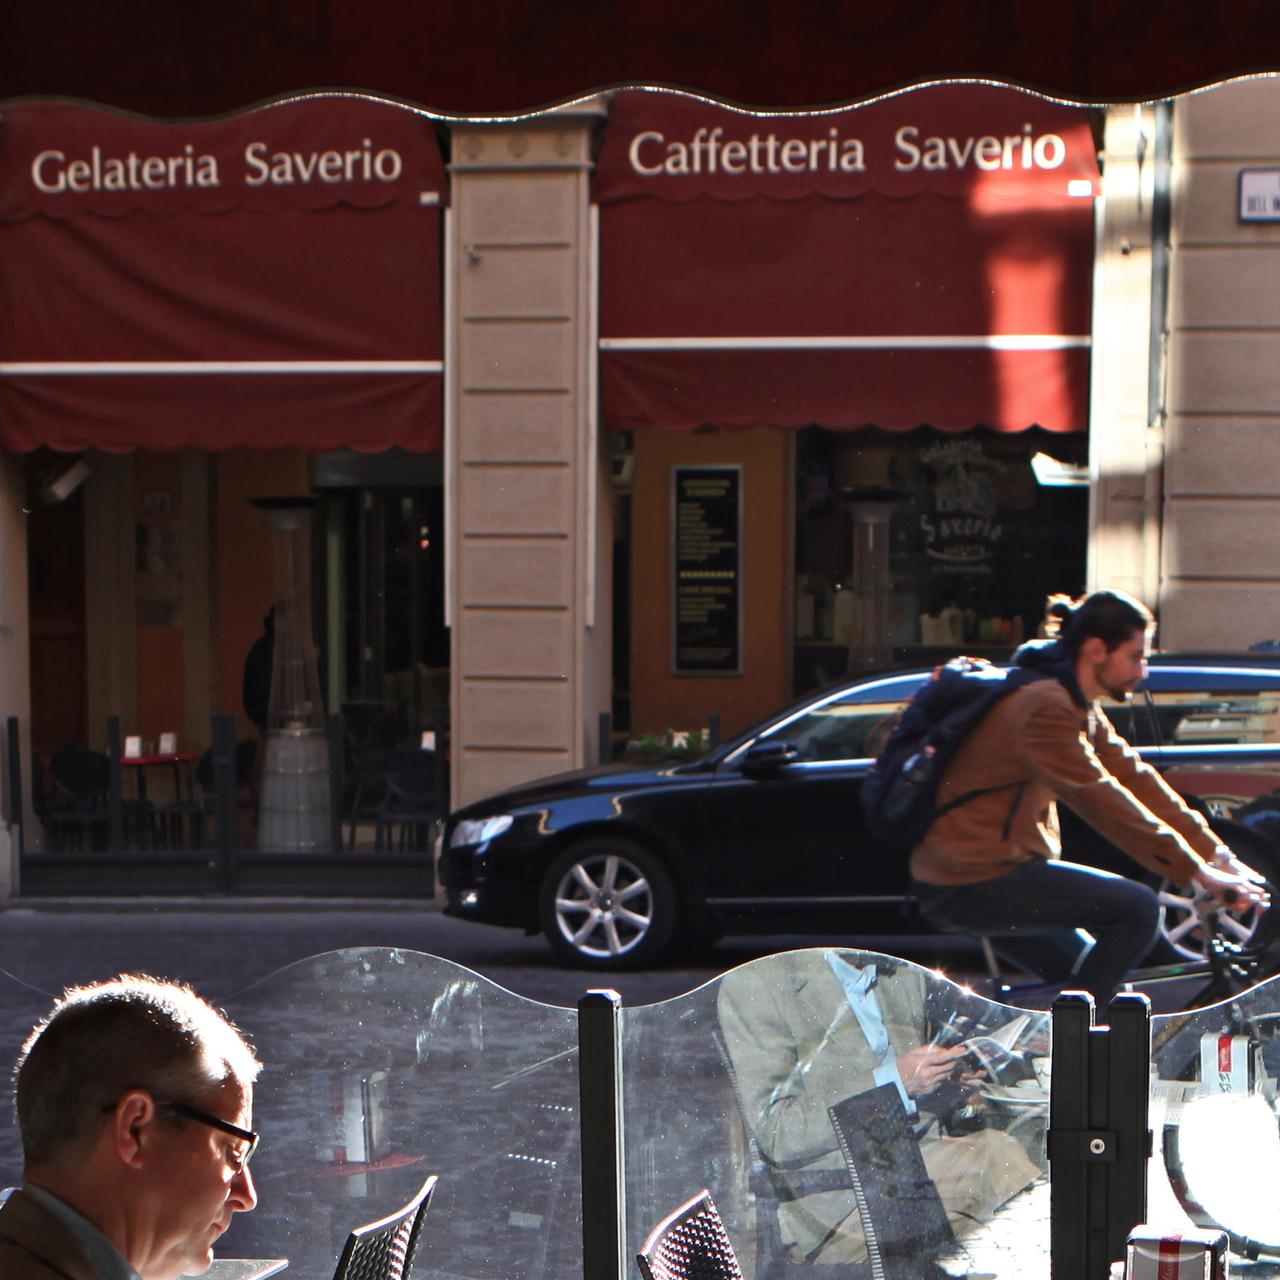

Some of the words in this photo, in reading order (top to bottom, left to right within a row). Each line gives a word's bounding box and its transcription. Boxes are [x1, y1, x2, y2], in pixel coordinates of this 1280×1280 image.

[31, 144, 220, 194] Gelateria
[244, 138, 403, 187] Saverio
[628, 126, 867, 176] Caffetteria
[893, 123, 1067, 173] Saverio
